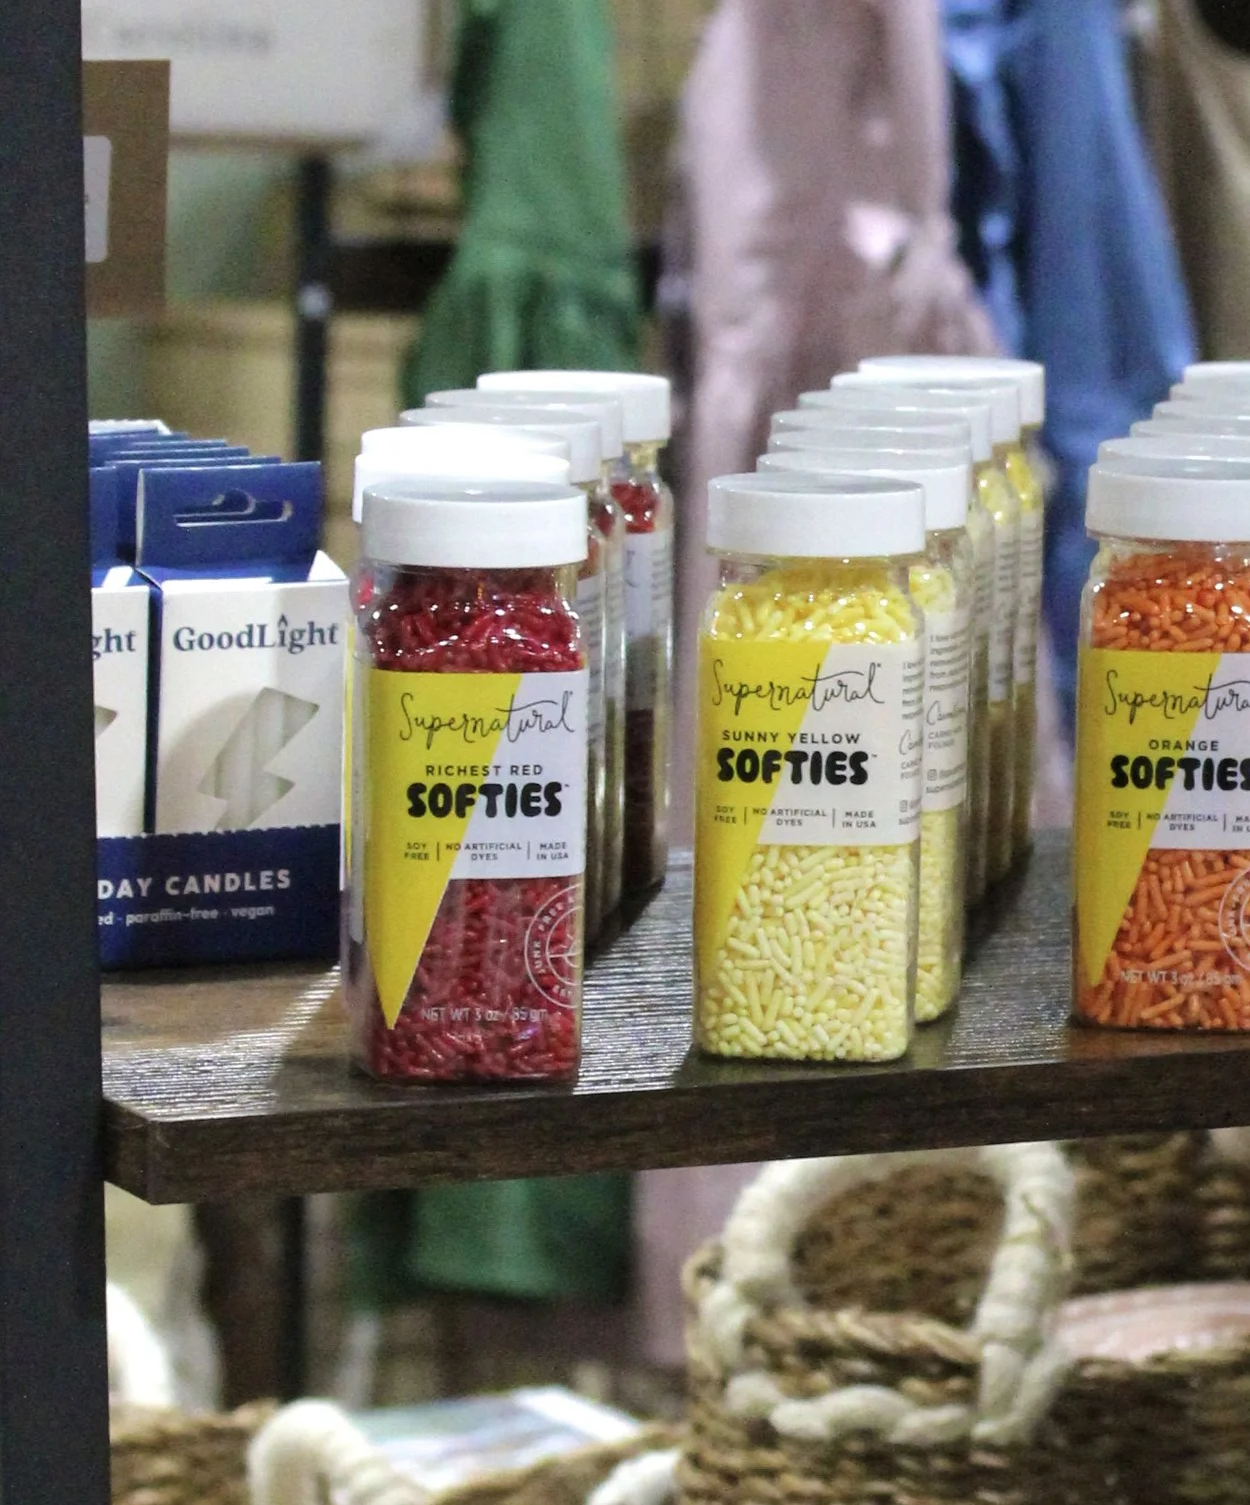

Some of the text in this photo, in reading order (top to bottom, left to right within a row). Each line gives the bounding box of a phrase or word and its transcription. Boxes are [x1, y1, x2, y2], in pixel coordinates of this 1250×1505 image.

[173, 614, 339, 655] GoodLight
[712, 659, 885, 716] Supernatural
[399, 690, 575, 750] Supernatural
[722, 730, 861, 744] SUNNY YELLOW
[1148, 739, 1220, 751] ORANGE
[425, 764, 544, 776] RICHEST RED
[717, 748, 869, 785] SOFTIES
[406, 781, 562, 818] SOFTIES
[716, 805, 734, 814] SOY
[752, 807, 827, 817] NO ARTIFICIAL
[845, 810, 874, 818] MADE
[714, 815, 737, 824] FREE
[1146, 813, 1218, 822] NO ARTIFICIAL
[776, 818, 803, 827] DYES
[842, 820, 877, 828] IN USA
[406, 842, 426, 850] SOY
[445, 842, 522, 850] NO ARTIFICIAL
[540, 842, 567, 850] MADE
[404, 852, 430, 861] FREE
[471, 853, 498, 861] DYES
[551, 852, 569, 860] USA
[165, 869, 291, 896] CANDLES
[422, 1007, 446, 1022] NET
[450, 1007, 470, 1022] WT
